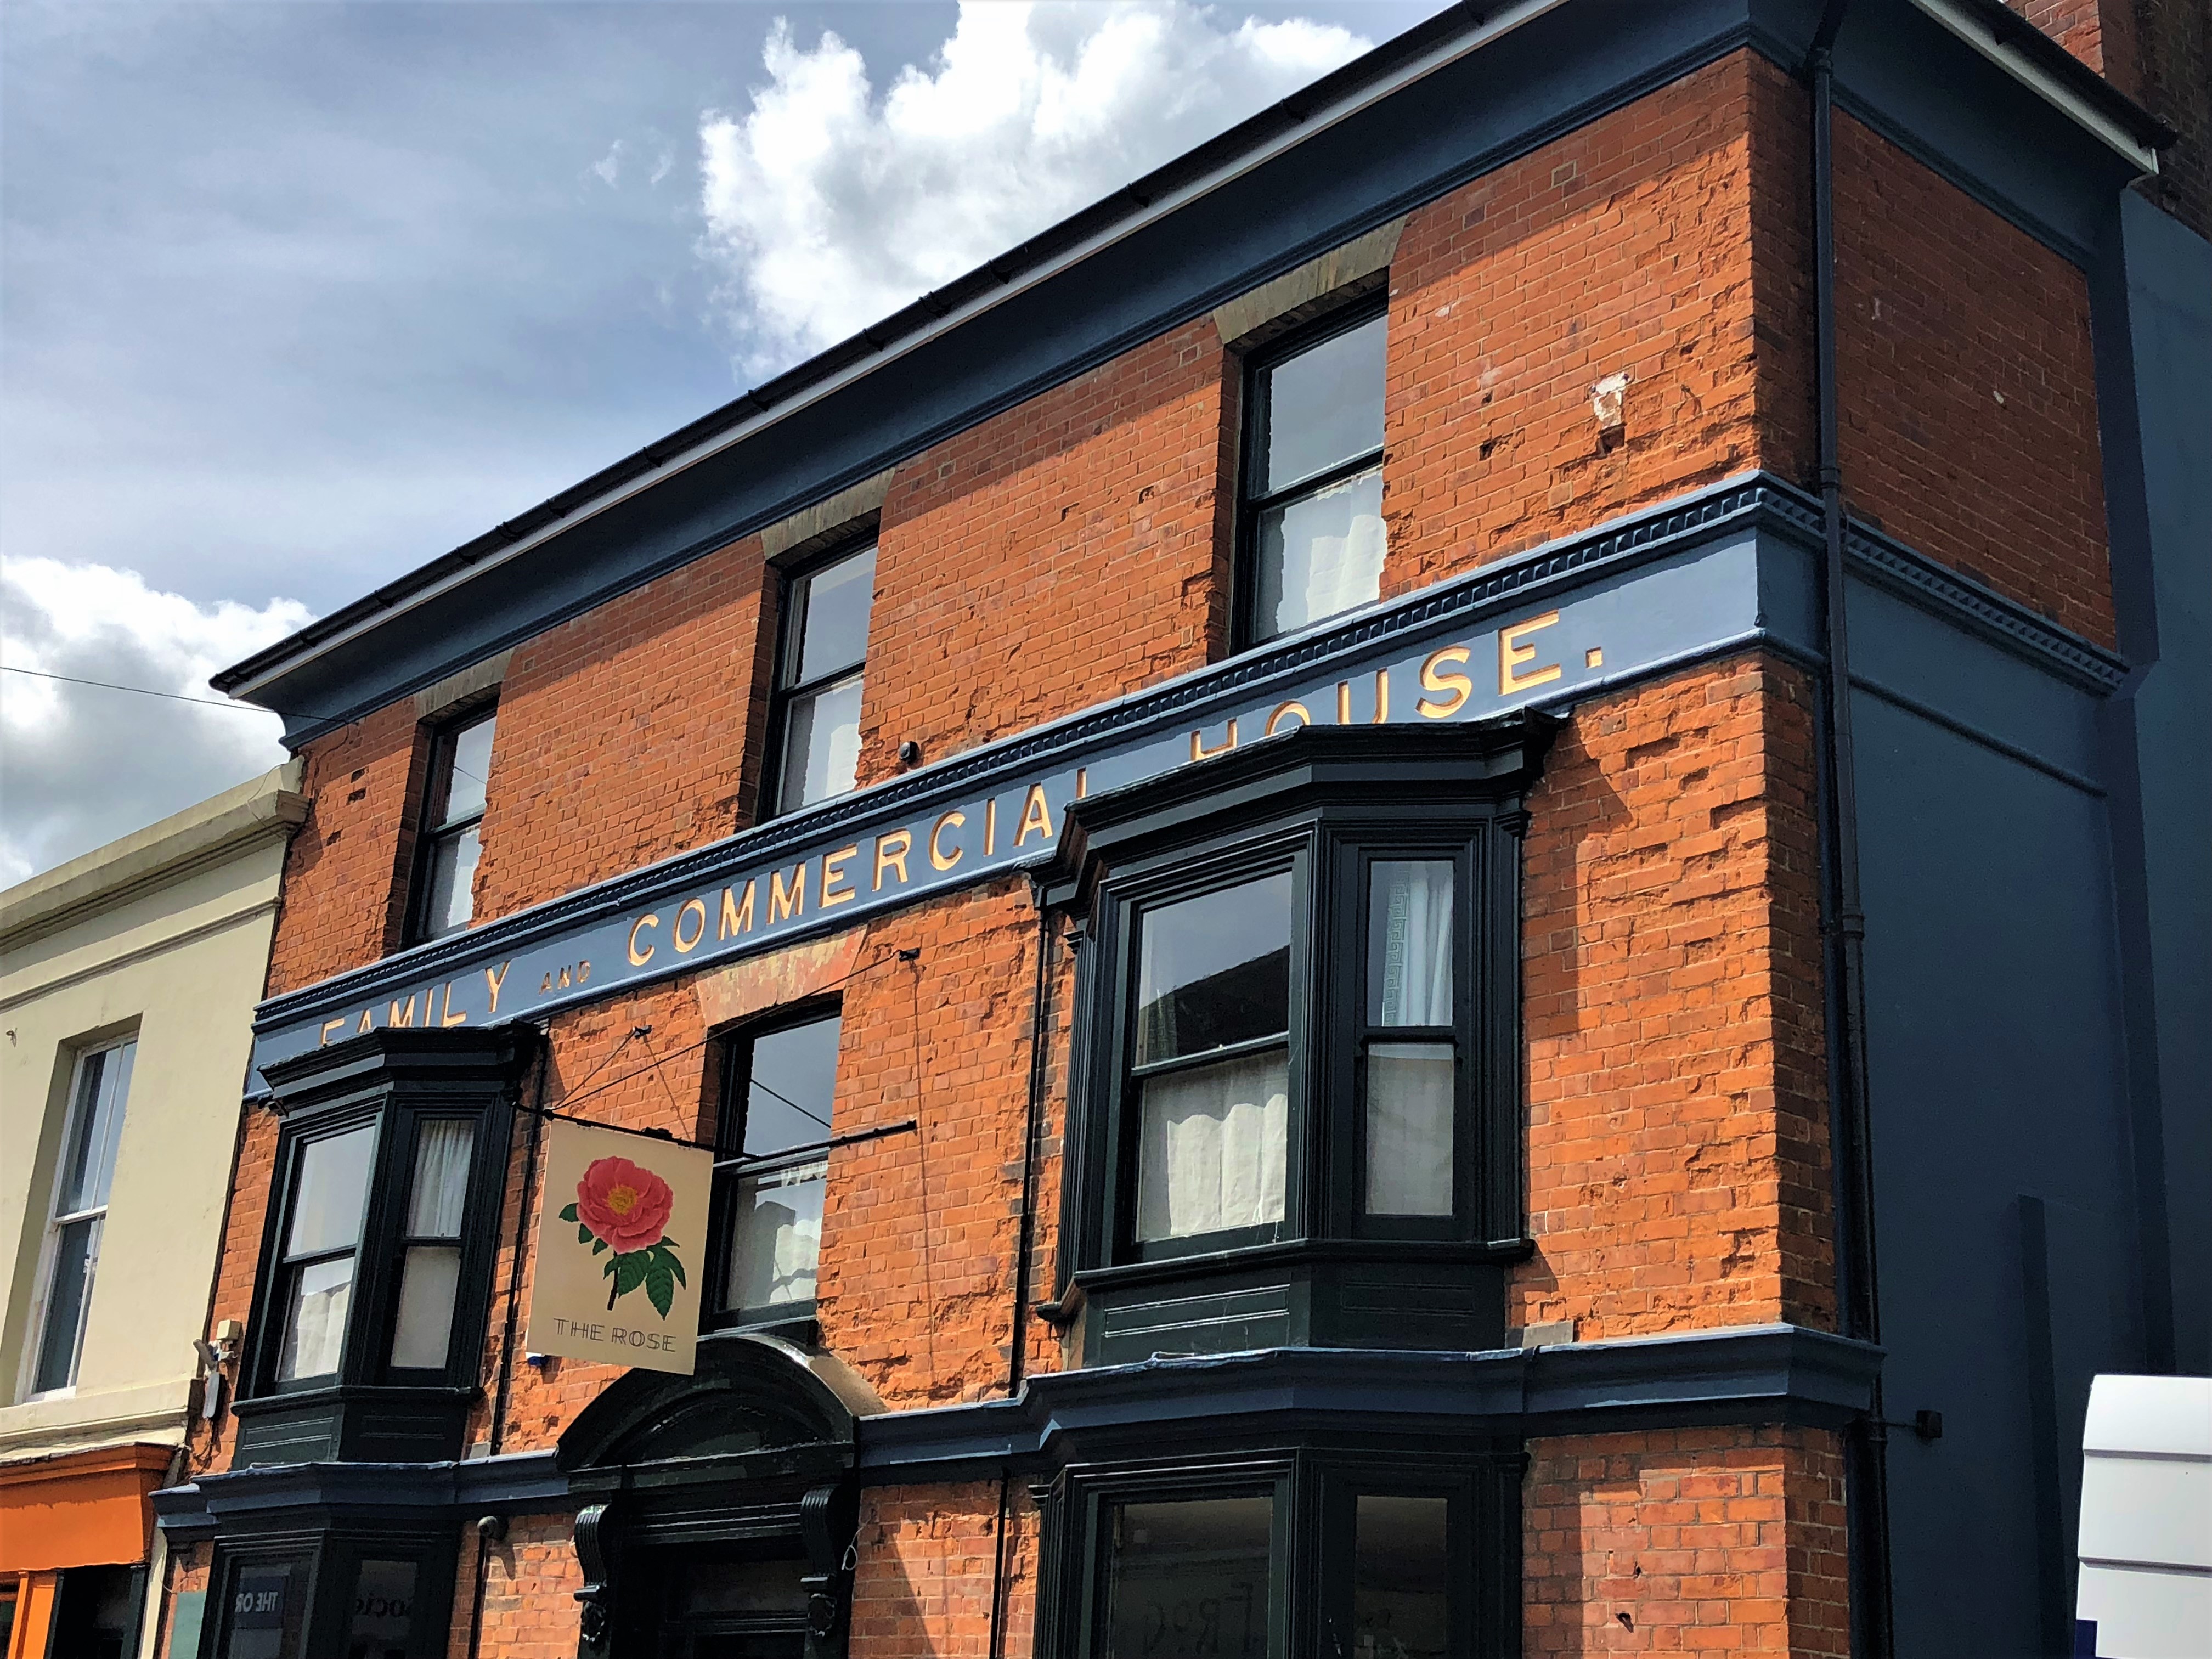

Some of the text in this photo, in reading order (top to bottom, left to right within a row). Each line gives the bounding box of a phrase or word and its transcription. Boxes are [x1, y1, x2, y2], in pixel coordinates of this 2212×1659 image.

[538, 959, 591, 995] AND
[554, 1318, 677, 1352] THE ROSE
